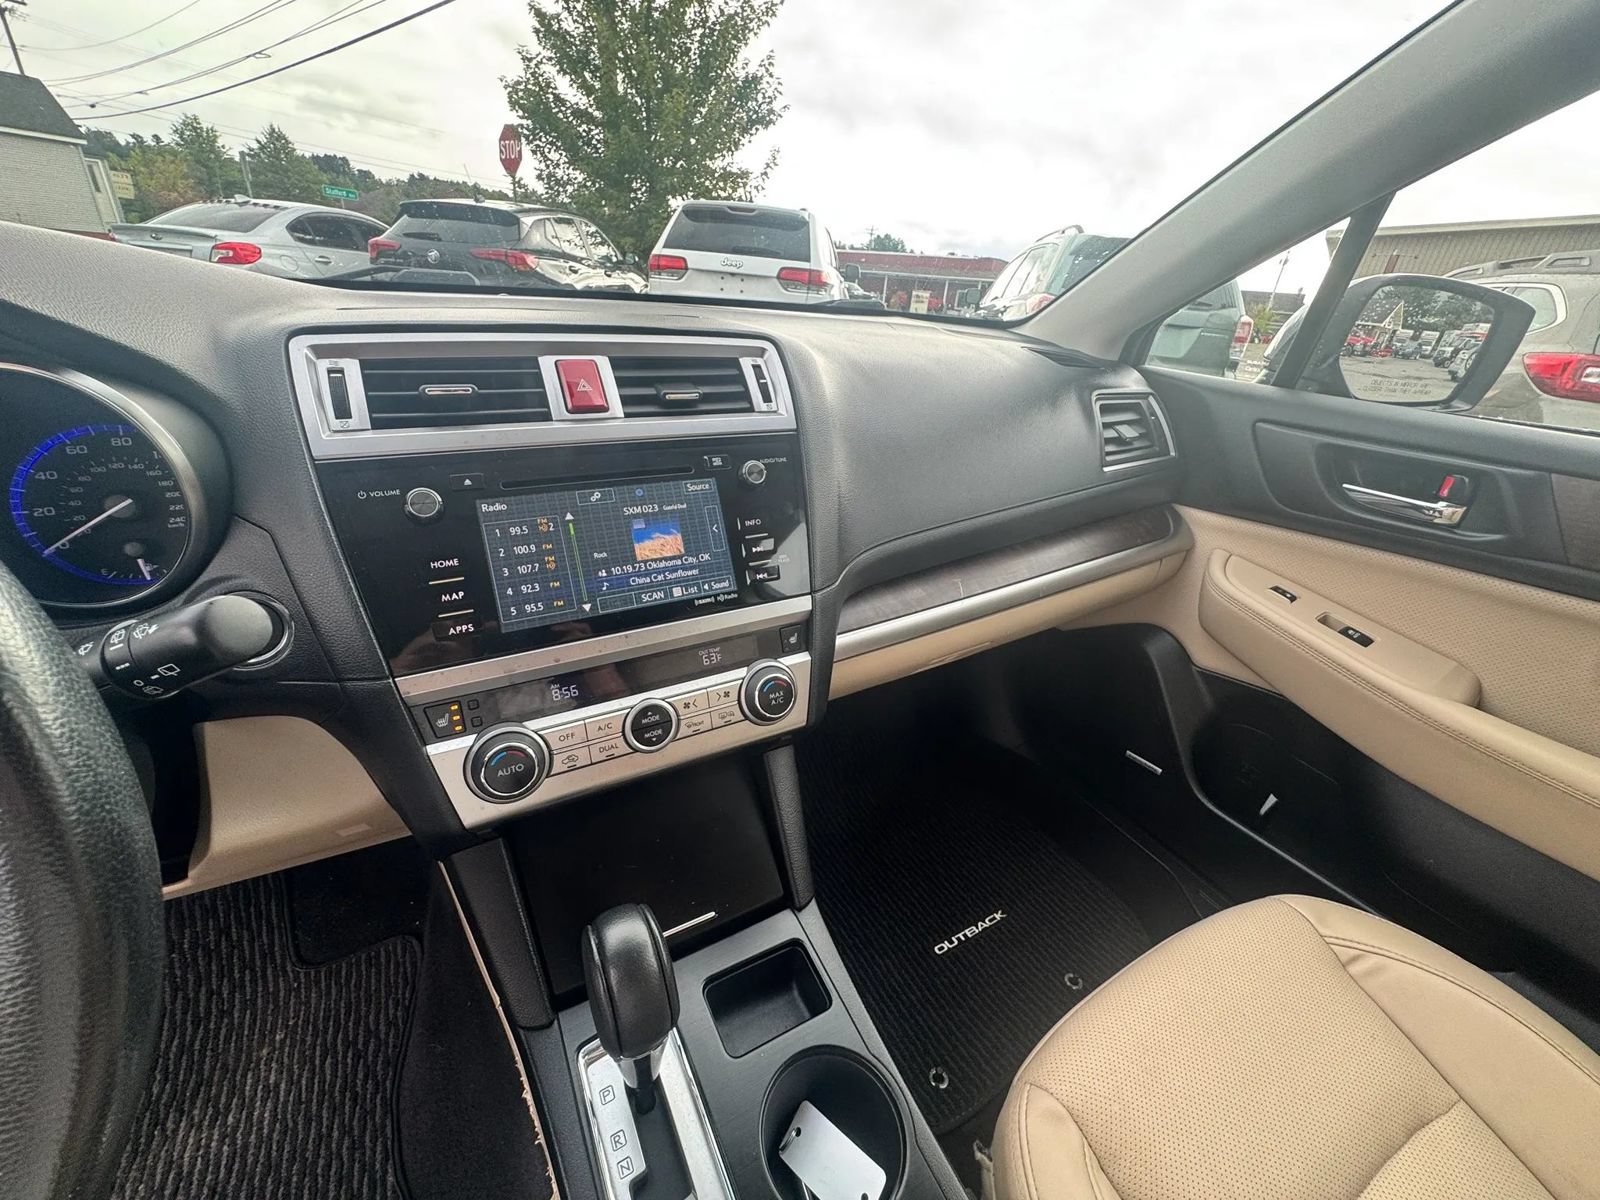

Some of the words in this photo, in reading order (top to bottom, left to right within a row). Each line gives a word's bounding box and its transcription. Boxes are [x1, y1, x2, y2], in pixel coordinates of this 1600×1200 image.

[500, 140, 520, 159] STOP
[720, 256, 744, 269] Jeep
[110, 436, 132, 446] 80
[66, 445, 88, 454] 60
[34, 470, 58, 480] 40
[686, 483, 709, 491] Source
[368, 489, 400, 497] VOLUME
[33, 506, 56, 516] 20
[482, 503, 508, 512] Radio
[624, 505, 642, 515] SXM
[643, 504, 659, 513] 023
[509, 526, 528, 536] 99.5
[549, 523, 555, 531] 2
[513, 544, 536, 555] 100.9
[430, 558, 459, 568] HOME
[611, 562, 645, 575] 10.19.73
[647, 559, 682, 570] Oklahoma
[683, 556, 698, 566] City,
[699, 553, 711, 562] OK
[502, 568, 509, 576] 3
[517, 564, 539, 574] 107.7
[630, 576, 650, 586] China
[652, 573, 665, 582] Cat
[665, 568, 699, 580] Sunflower
[521, 583, 540, 594] 92.3
[711, 579, 729, 589] Sound
[683, 585, 698, 595] List
[441, 591, 464, 602] MAP
[642, 591, 665, 602] SCAN
[510, 607, 517, 615] 5
[525, 602, 544, 613] 95.5
[448, 624, 474, 636] APPS
[552, 685, 579, 701] 8:56
[769, 691, 784, 699] MAX
[771, 698, 784, 706] A/C
[642, 714, 660, 724] MODE
[597, 722, 613, 732] A/C
[559, 732, 575, 742] OFF
[644, 728, 663, 738] MODE
[598, 743, 619, 754] DUAL
[497, 763, 524, 778] AUTO
[934, 910, 1007, 954] OUTBACK
[602, 1089, 611, 1102] P
[613, 1134, 623, 1148] R
[620, 1160, 631, 1175] N
